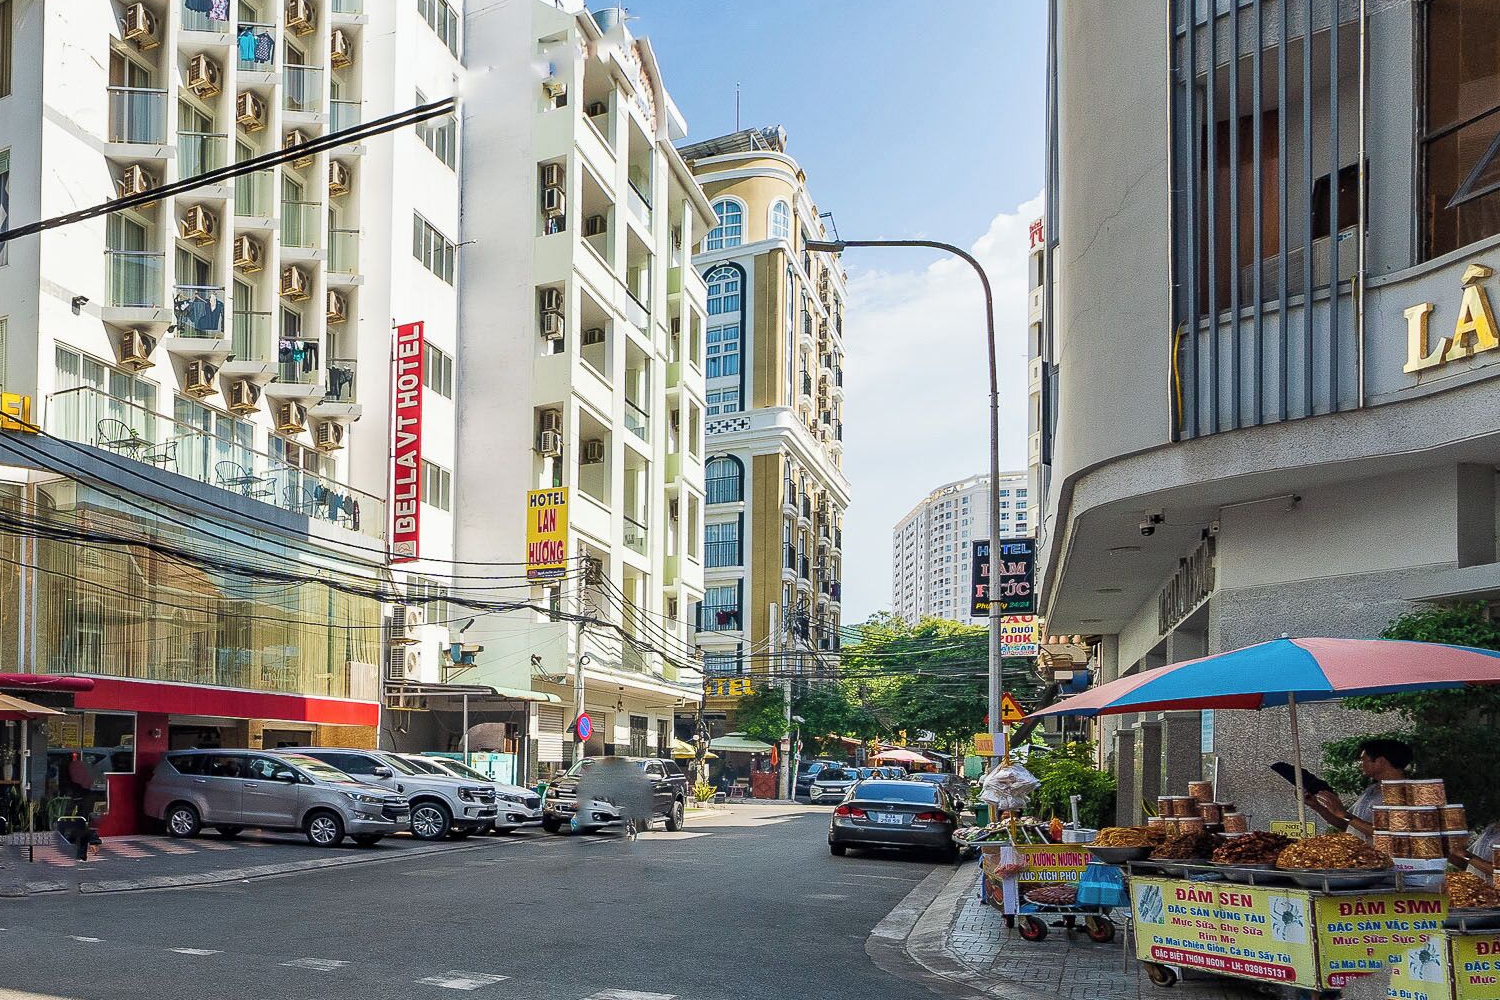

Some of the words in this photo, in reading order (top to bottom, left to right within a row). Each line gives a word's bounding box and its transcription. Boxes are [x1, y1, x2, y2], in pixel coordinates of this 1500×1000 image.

[397, 325, 420, 409] HOTEL
[396, 416, 417, 534] BELLAVT
[530, 492, 565, 507] HOTEL
[538, 509, 556, 533] LAN
[977, 544, 1031, 556] HTEL
[1219, 892, 1253, 907] SEN
[1165, 937, 1181, 947] Mai
[1199, 932, 1217, 942] Rim
[1220, 934, 1236, 944] Me
